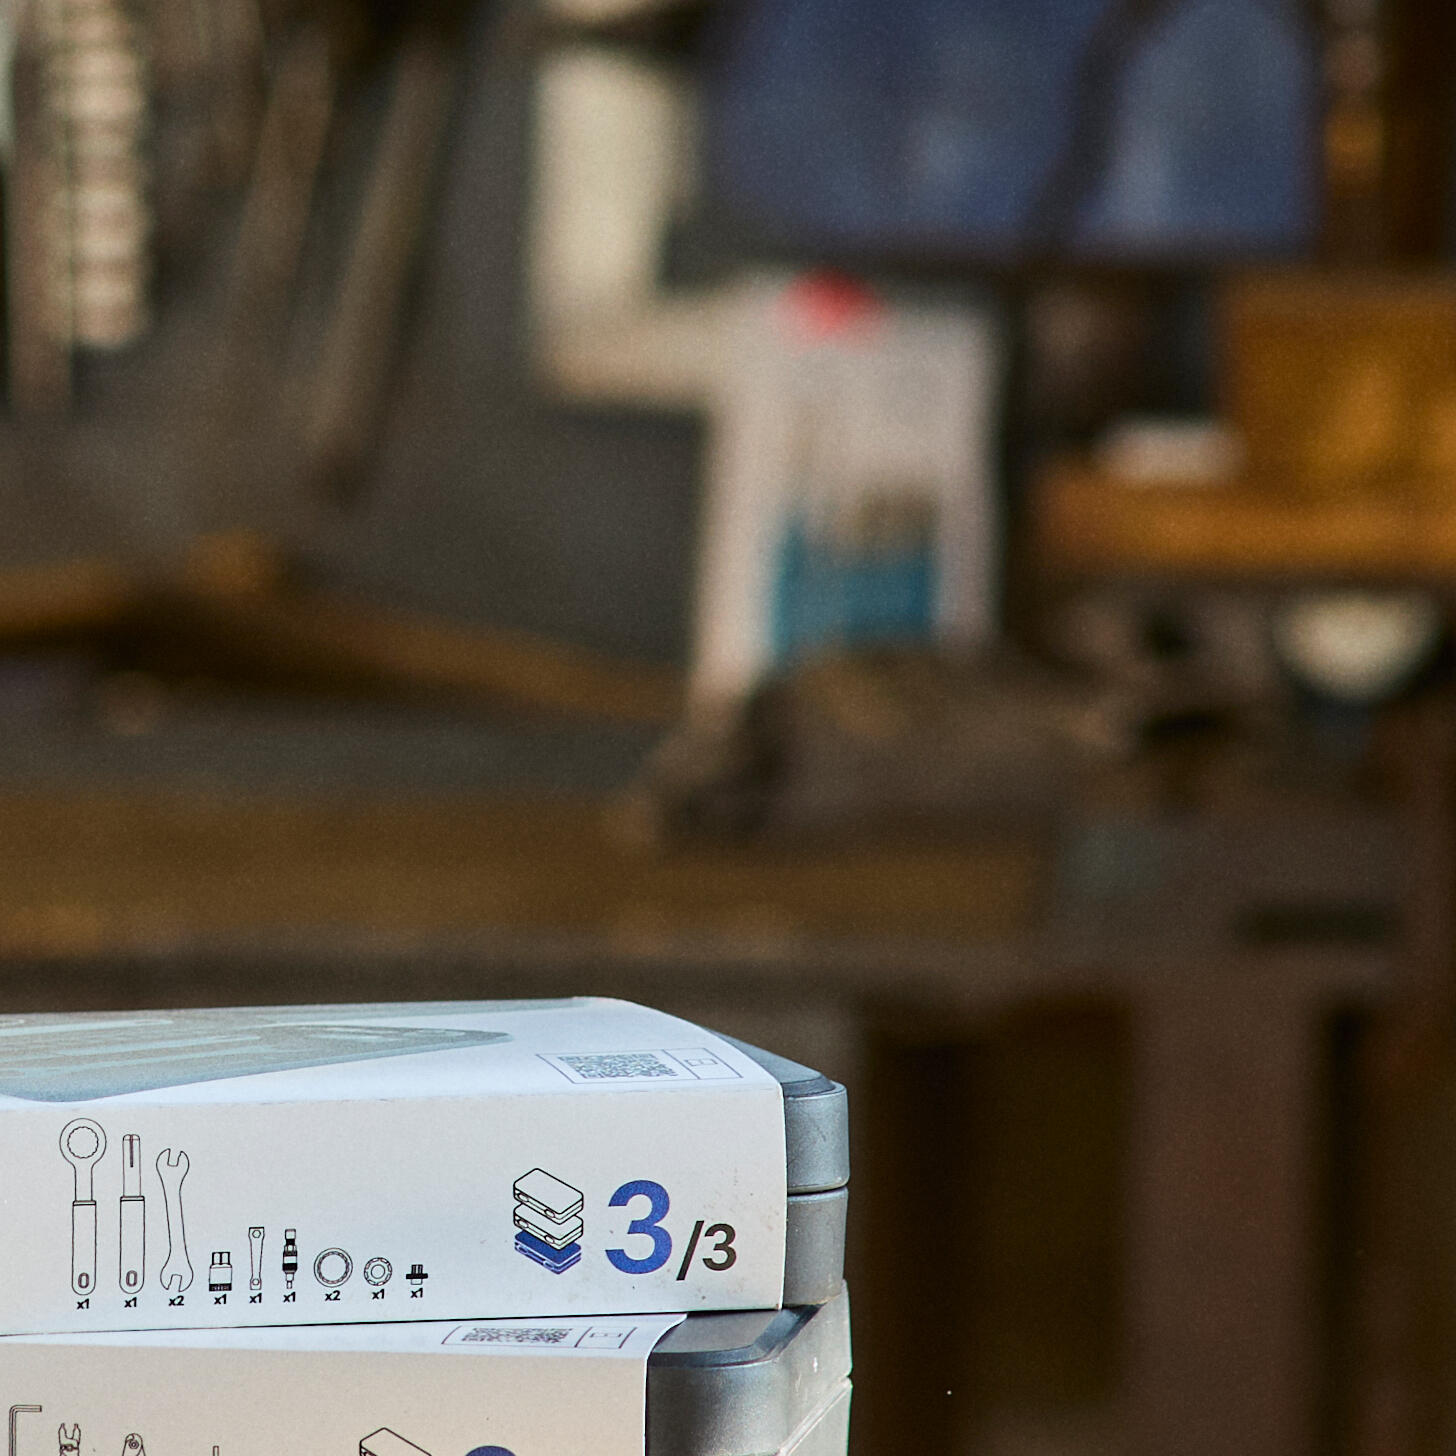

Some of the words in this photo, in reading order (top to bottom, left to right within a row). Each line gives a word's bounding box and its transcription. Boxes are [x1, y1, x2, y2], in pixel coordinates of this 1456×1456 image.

[76, 1297, 90, 1310] x1
[123, 1296, 138, 1308] x1
[168, 1294, 185, 1307] x2
[213, 1293, 227, 1305] x1
[249, 1292, 263, 1304] x1
[283, 1291, 296, 1303] x1
[324, 1289, 341, 1302] x2
[371, 1288, 385, 1300] x1
[410, 1287, 424, 1299] x1
